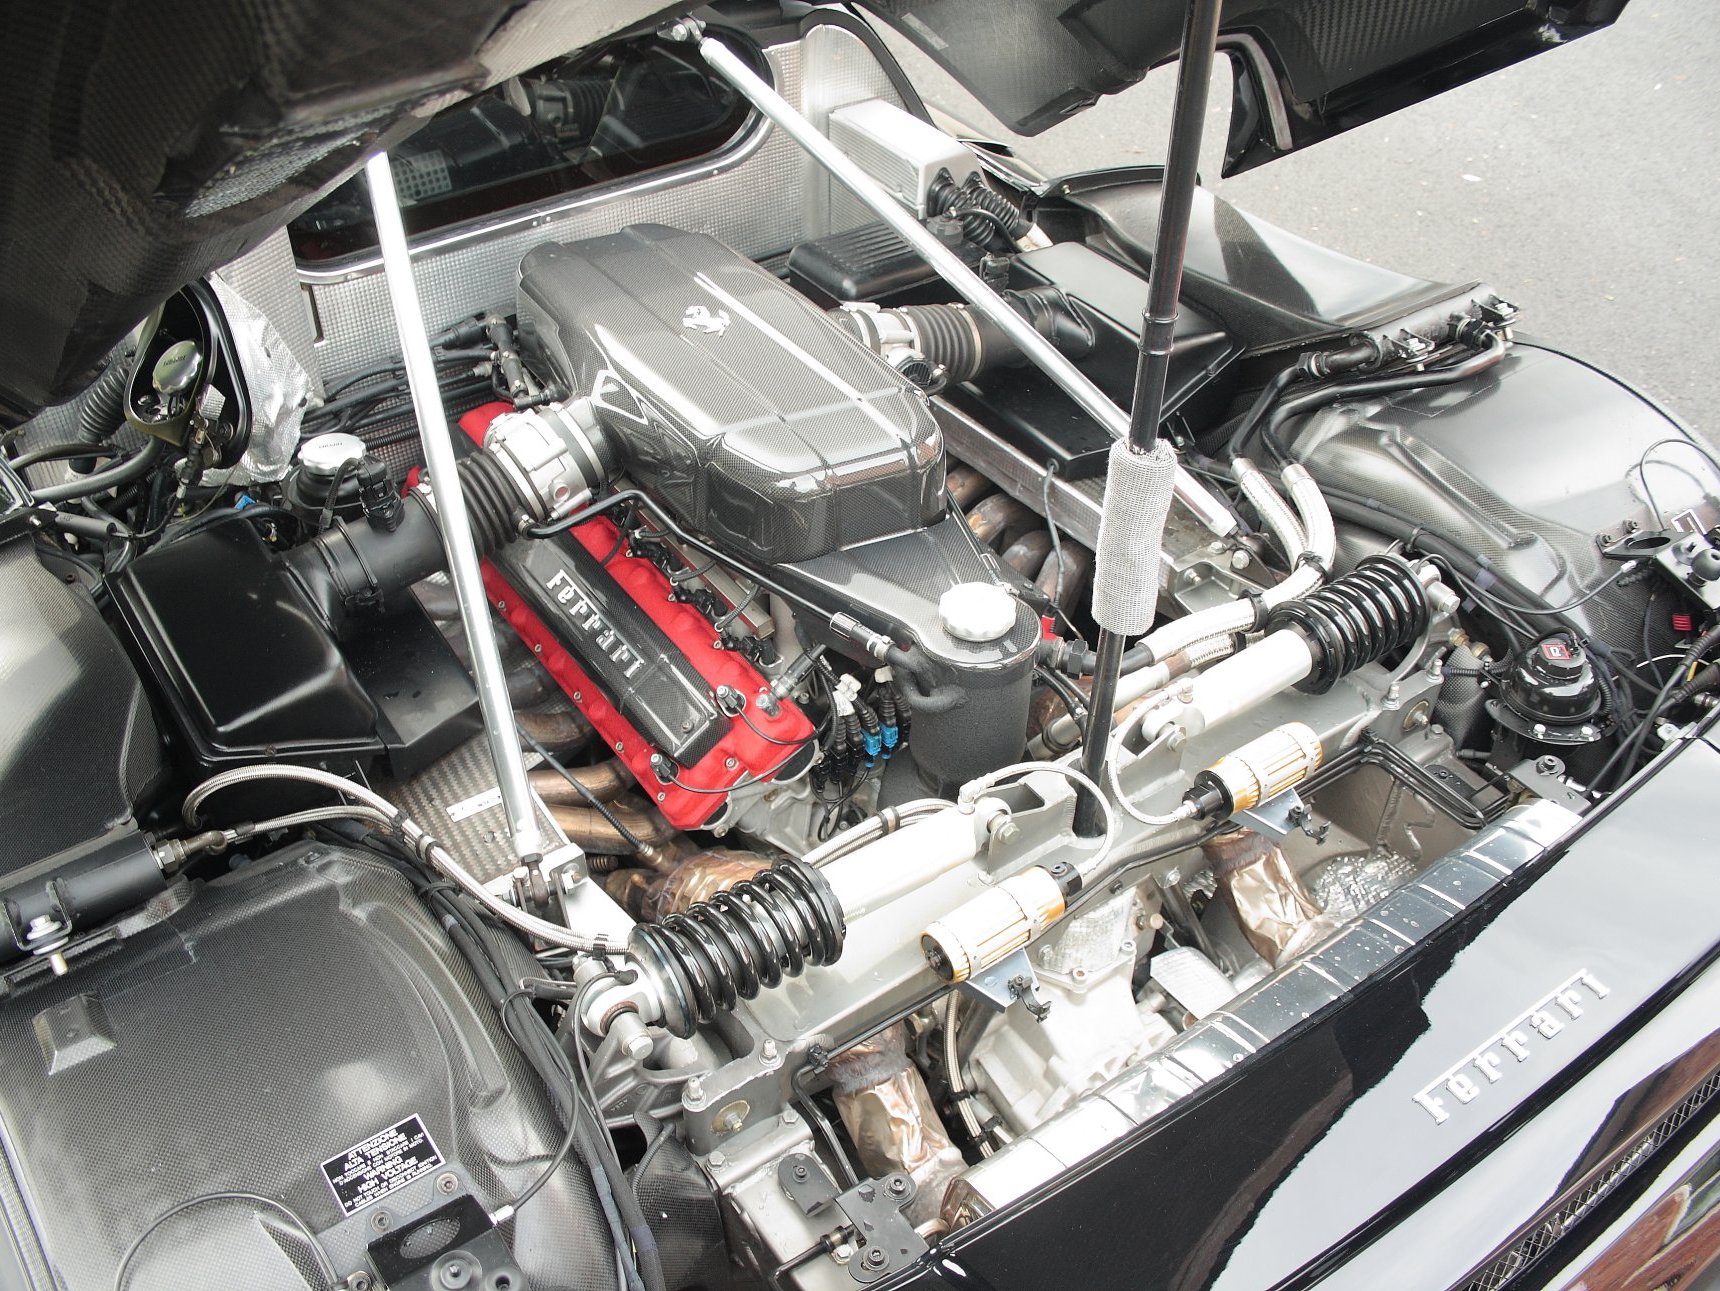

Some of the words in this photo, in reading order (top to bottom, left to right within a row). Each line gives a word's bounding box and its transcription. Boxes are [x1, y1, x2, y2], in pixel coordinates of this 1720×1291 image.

[546, 569, 645, 678] Ferrari
[1412, 968, 1611, 1124] Ferrari
[343, 1155, 364, 1171] ALTA
[365, 1133, 407, 1159] TENSIONE
[347, 1129, 398, 1160] ATTENZIONE
[357, 1177, 379, 1193] HIGH
[381, 1156, 418, 1181] VOLTAGE
[363, 1156, 403, 1181] WARNING
